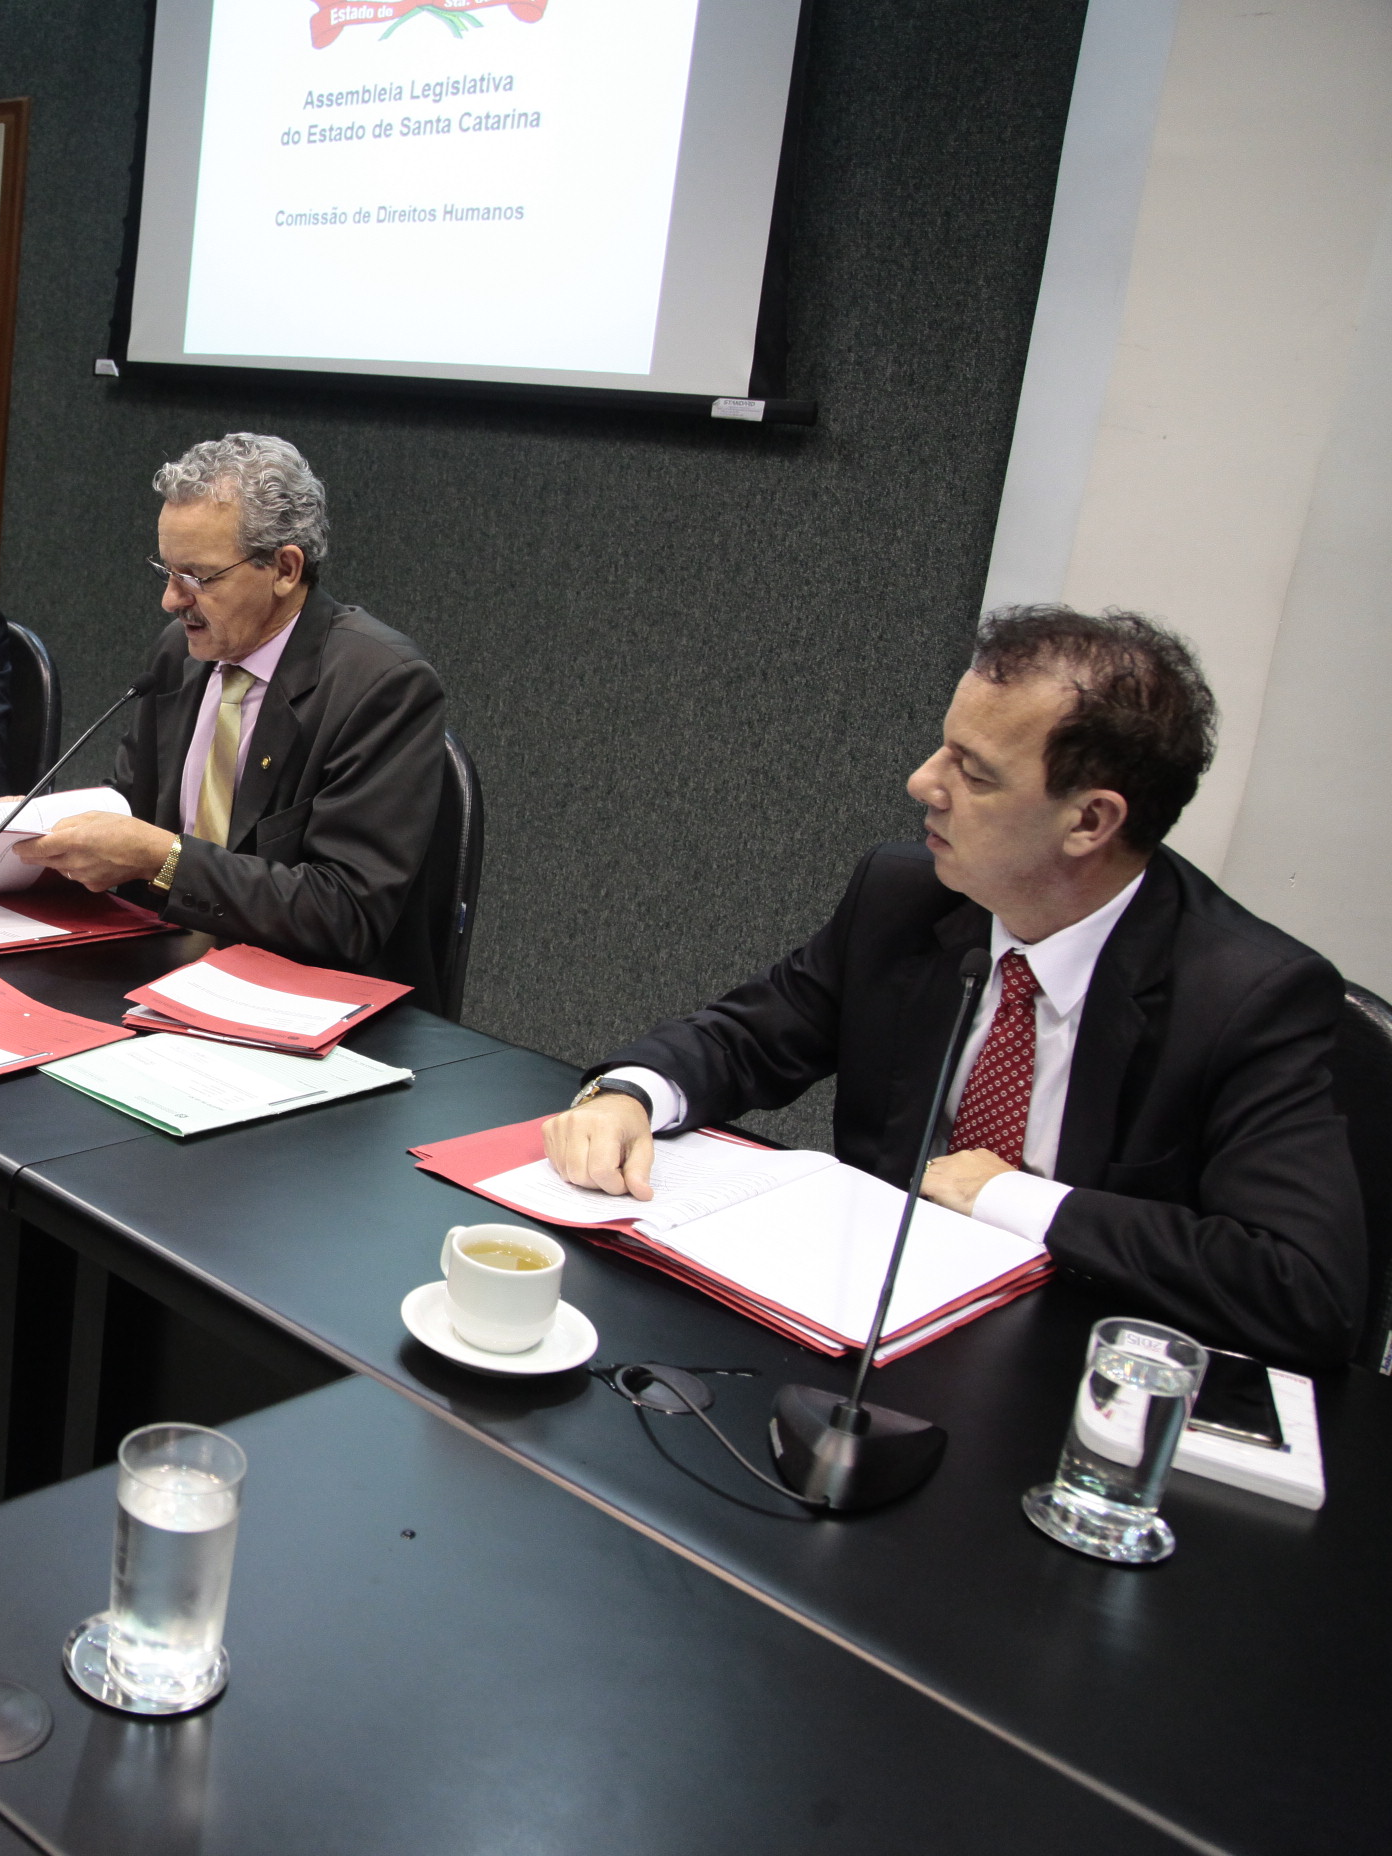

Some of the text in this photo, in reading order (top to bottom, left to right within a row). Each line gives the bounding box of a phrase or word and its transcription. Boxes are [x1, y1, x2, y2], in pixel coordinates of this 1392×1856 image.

[330, 4, 394, 25] Estado de
[302, 71, 515, 110] Assembleia Legislativa
[280, 107, 542, 146] do Estado de Santa Catarina
[274, 202, 525, 227] Comissão de Direitos Humanos
